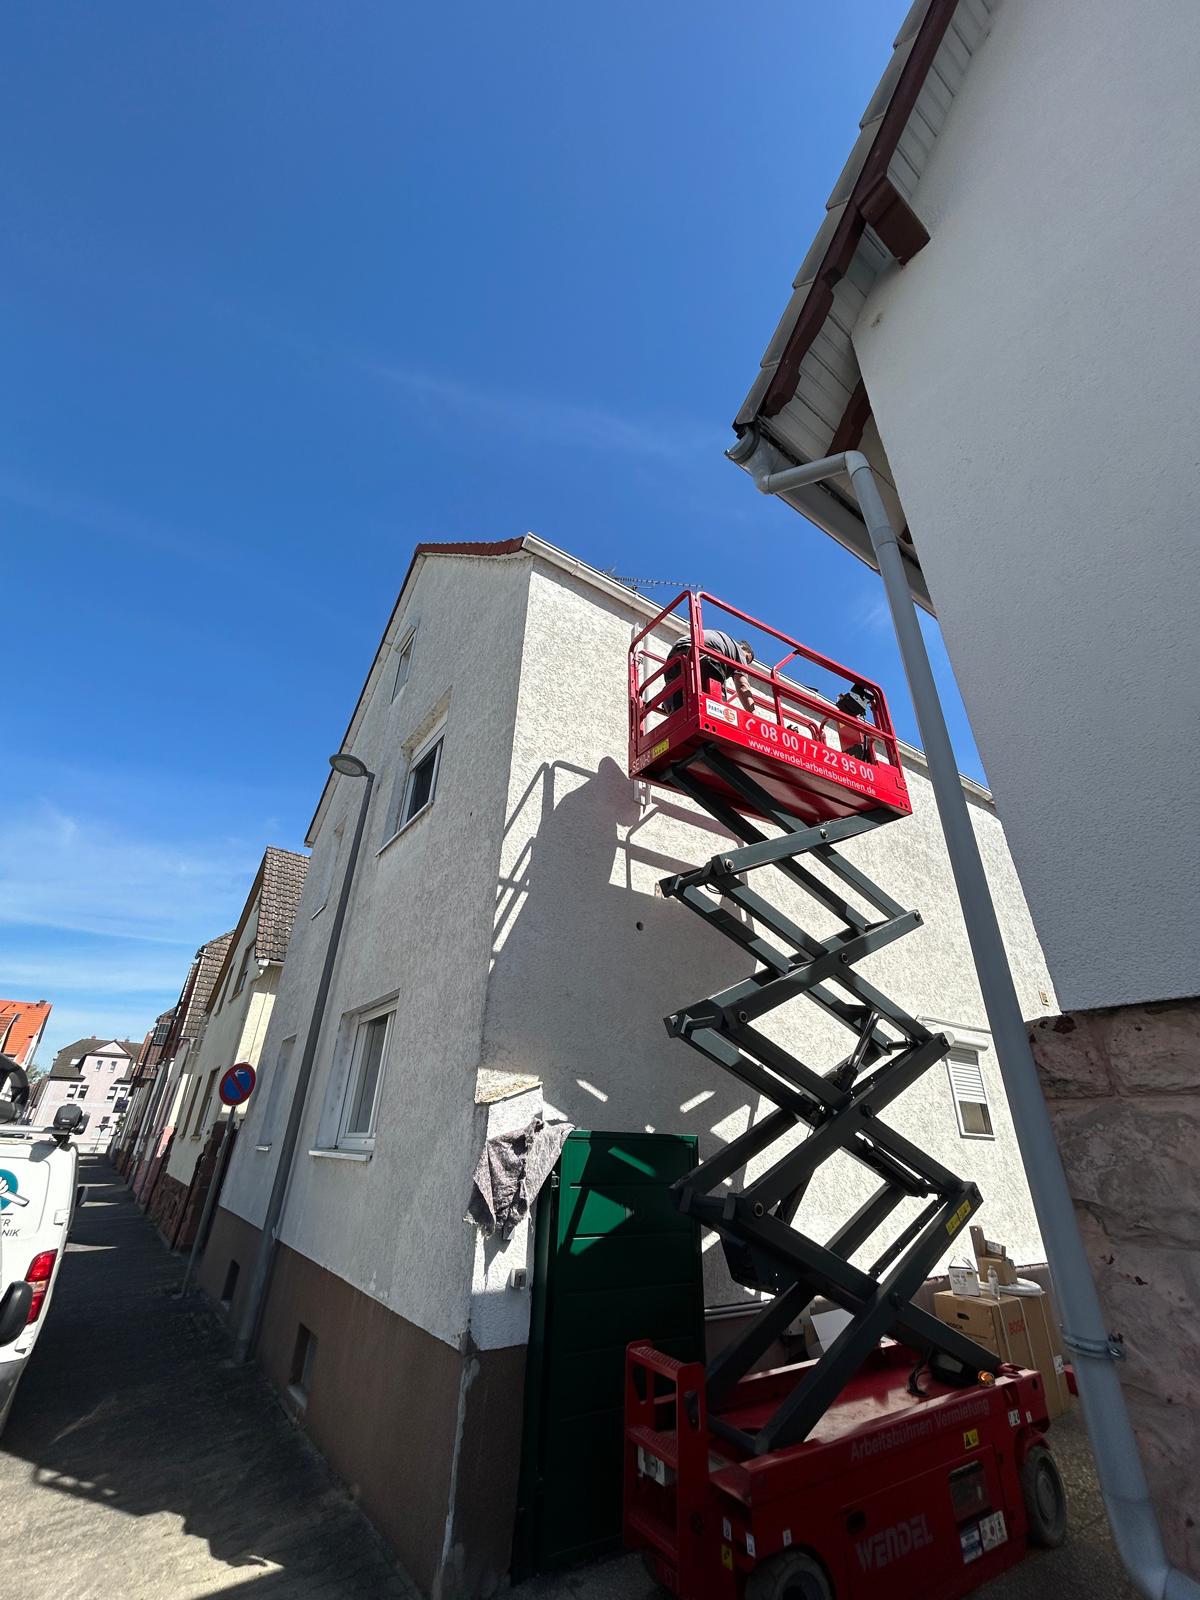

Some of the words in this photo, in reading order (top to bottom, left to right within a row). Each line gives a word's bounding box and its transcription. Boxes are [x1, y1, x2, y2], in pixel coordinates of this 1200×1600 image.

[748, 739, 876, 796] www.wendel-arbeitsbuehnen.de
[761, 723, 778, 742] 08
[782, 732, 799, 751] 00
[810, 744, 818, 758] 7
[822, 749, 839, 767] 22
[841, 757, 857, 775] 95
[860, 765, 874, 782] 00
[851, 1419, 933, 1463] Arbeitsbühnen
[934, 1399, 991, 1434] Vermietung
[855, 1512, 933, 1574] WENDEL
